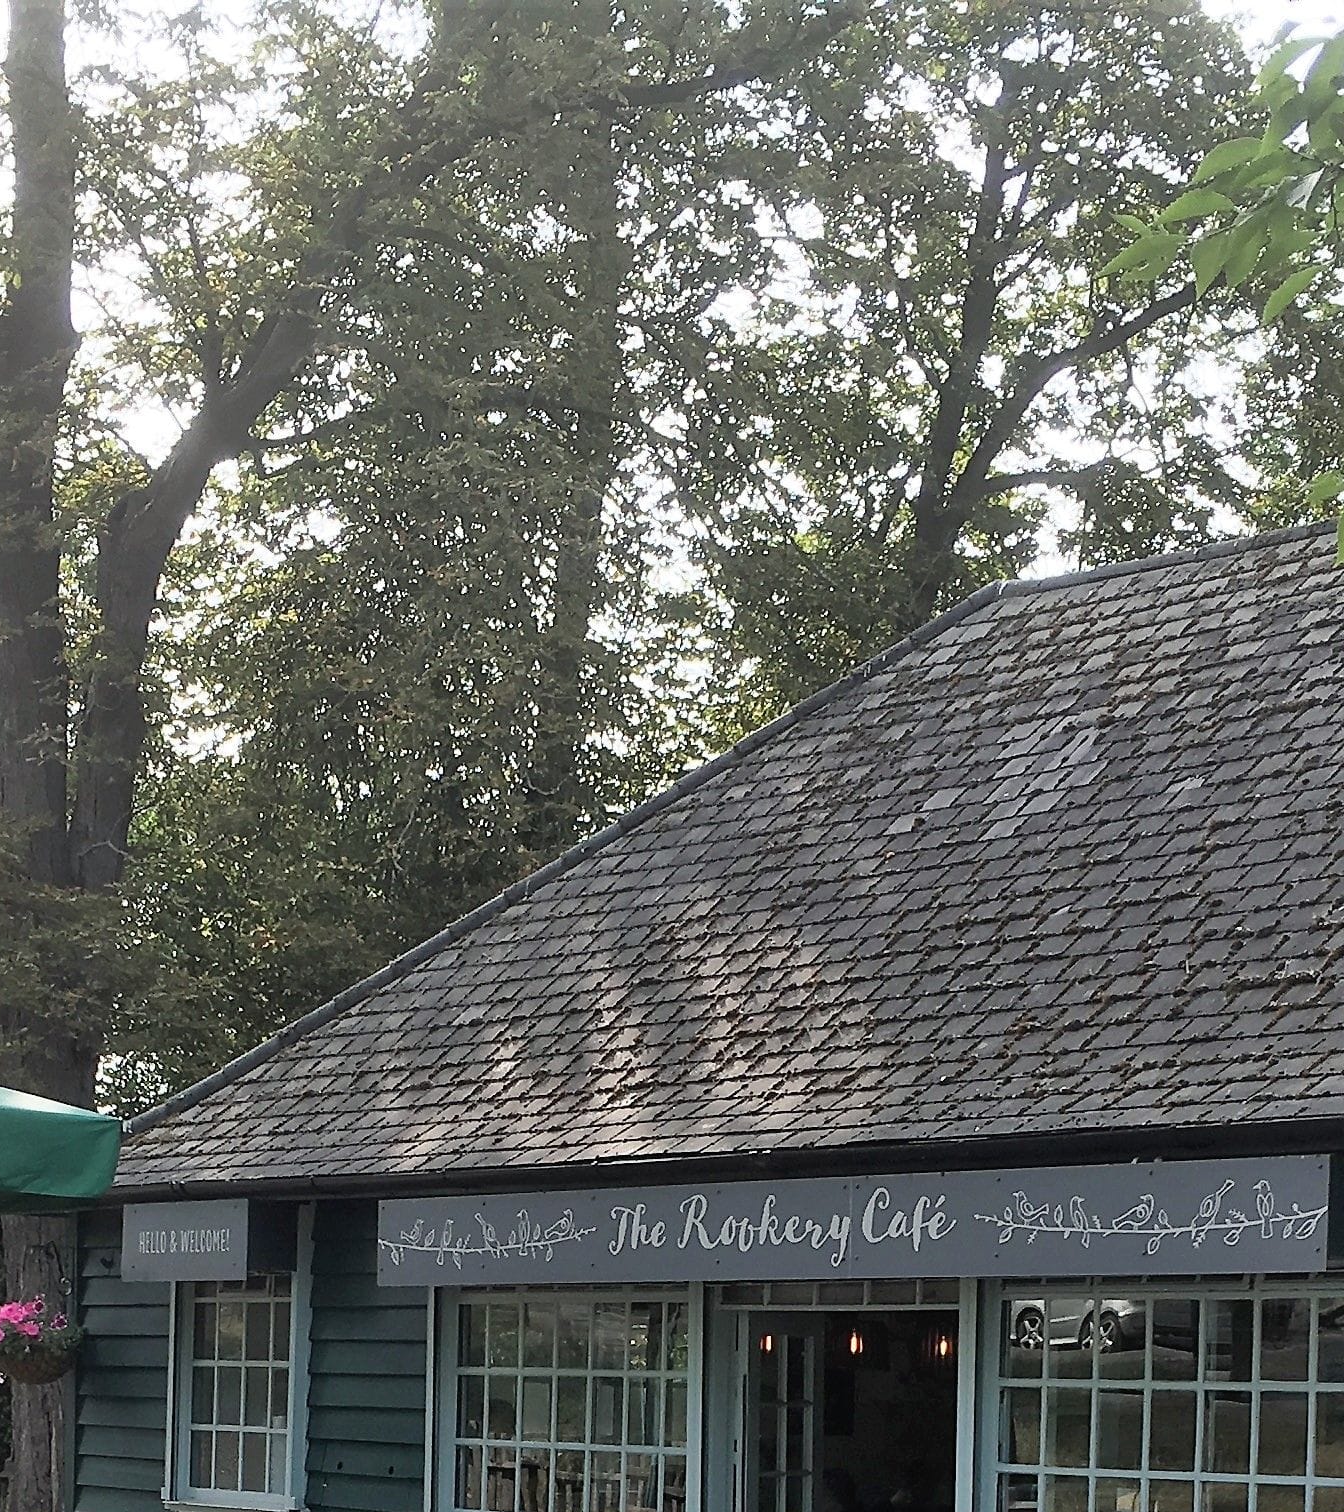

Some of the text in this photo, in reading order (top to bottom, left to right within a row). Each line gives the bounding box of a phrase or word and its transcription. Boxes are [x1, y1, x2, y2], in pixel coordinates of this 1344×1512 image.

[139, 1228, 231, 1254] HELLO & WELCOME!
[609, 1187, 957, 1267] The Rookery Café
